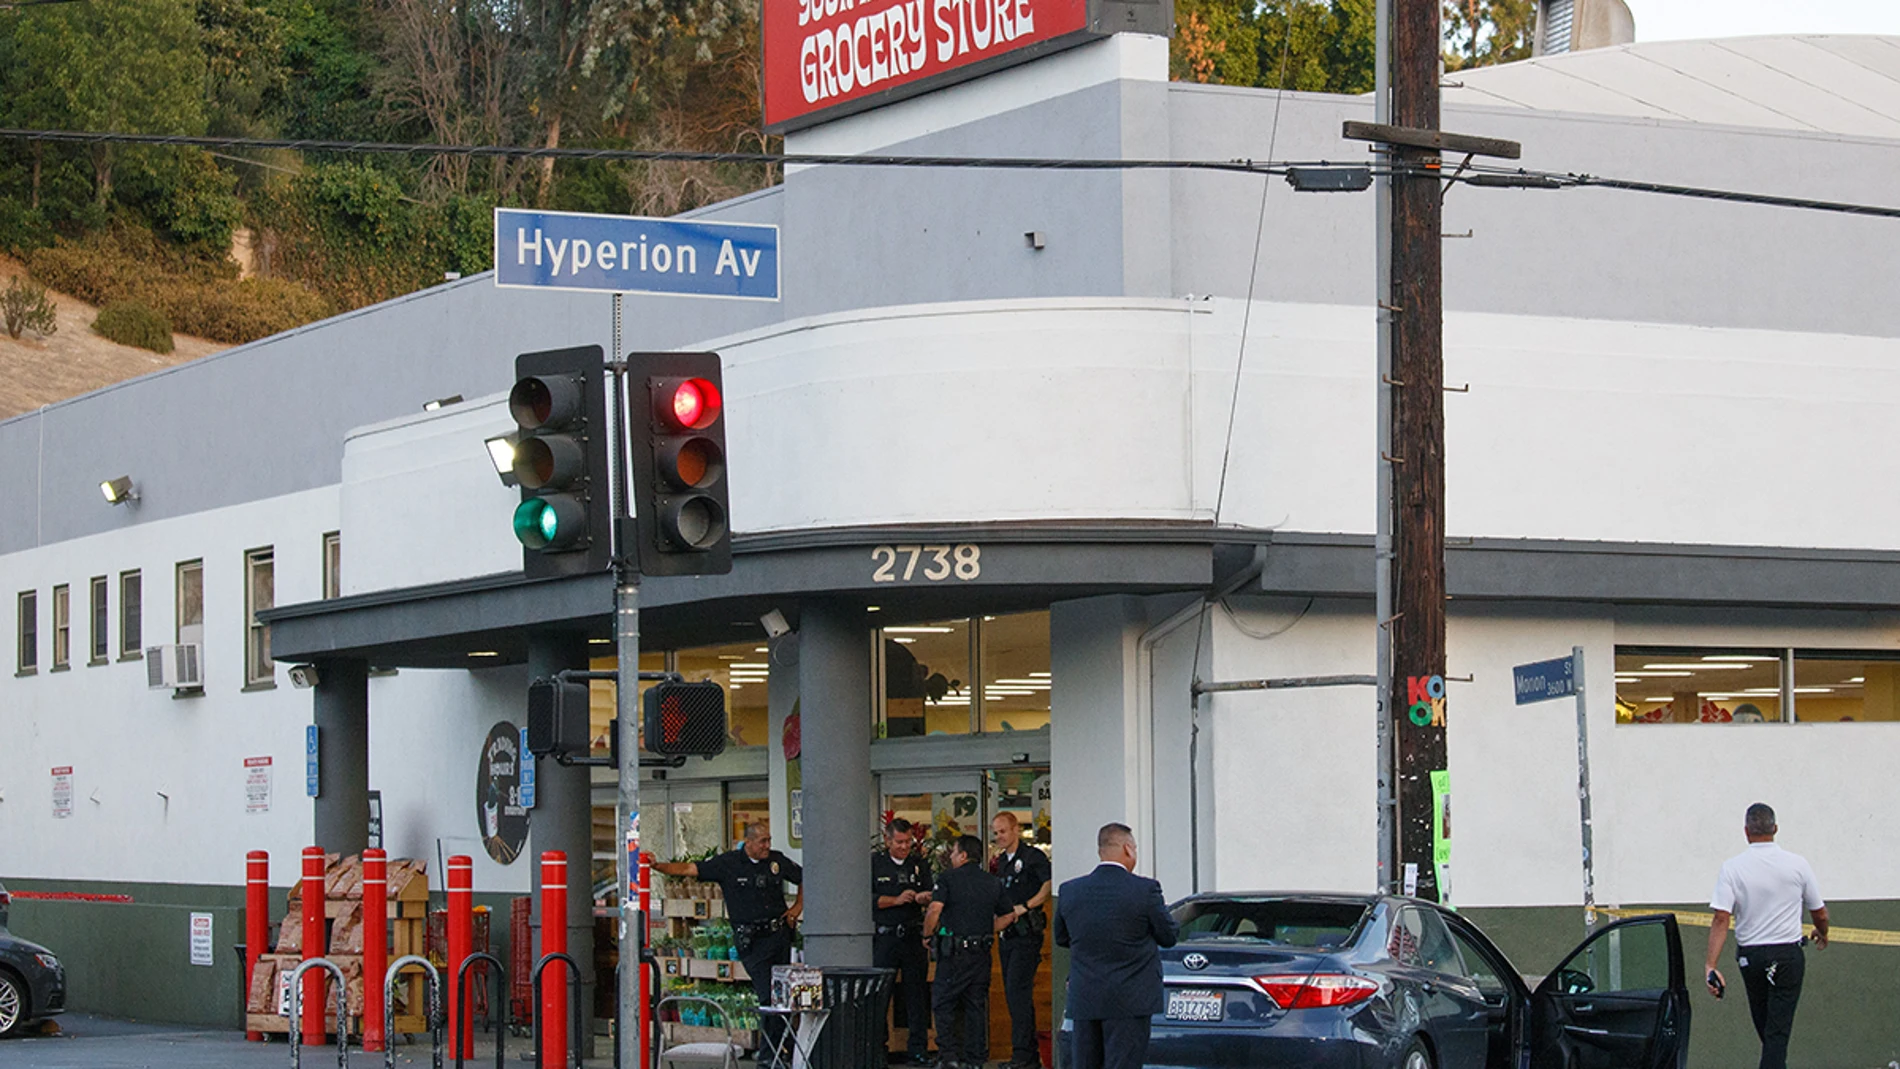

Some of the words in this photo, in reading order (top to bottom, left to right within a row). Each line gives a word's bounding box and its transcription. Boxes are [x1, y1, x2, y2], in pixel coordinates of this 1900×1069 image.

[799, 0, 854, 26] YOU
[801, 0, 926, 103] GROCERY
[934, 0, 1035, 63] STORE
[517, 227, 696, 276] Hyperion
[715, 239, 762, 277] Av
[872, 544, 981, 582] 2738
[1516, 675, 1546, 694] Monon
[1038, 788, 1051, 800] BA
